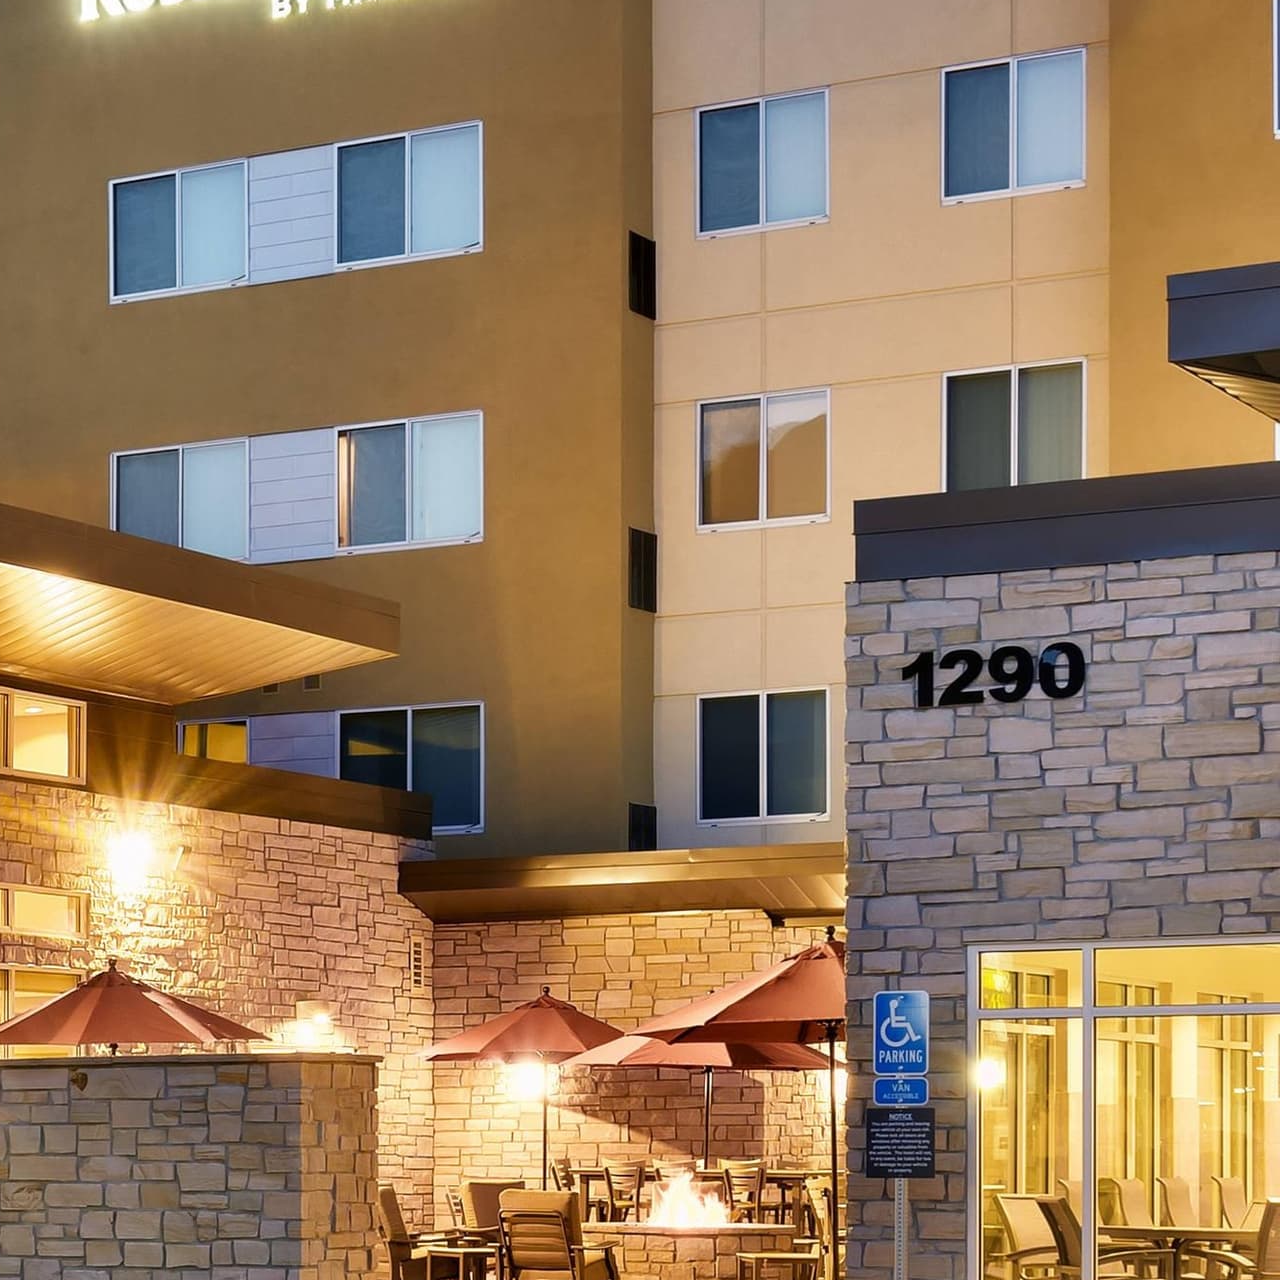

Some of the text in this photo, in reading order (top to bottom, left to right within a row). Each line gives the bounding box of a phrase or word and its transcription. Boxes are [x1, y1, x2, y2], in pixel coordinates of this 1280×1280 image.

[901, 641, 1086, 708] 1290
[879, 1049, 923, 1063] PARKING
[891, 1083, 911, 1092] VAN
